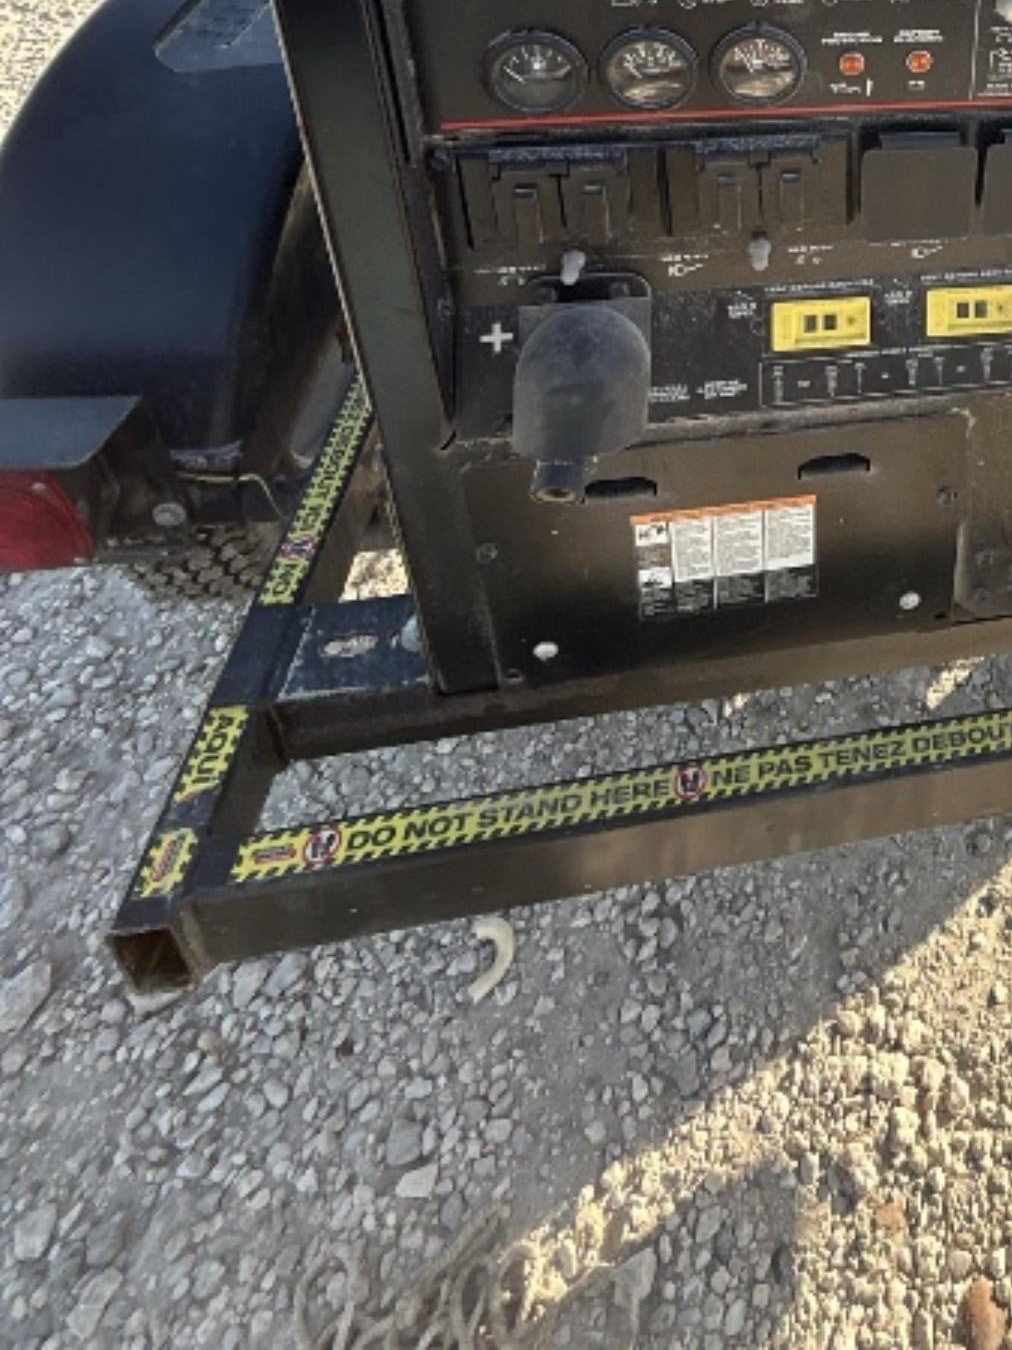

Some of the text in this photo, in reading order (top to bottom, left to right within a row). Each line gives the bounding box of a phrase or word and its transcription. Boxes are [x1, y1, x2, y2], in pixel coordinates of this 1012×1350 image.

[347, 823, 398, 851] DO
[405, 813, 468, 845] NOT
[479, 791, 583, 829] STAND
[590, 777, 671, 808] HERE
[711, 763, 752, 788] NE
[758, 754, 813, 781] PAS
[820, 739, 908, 771] TENEZ
